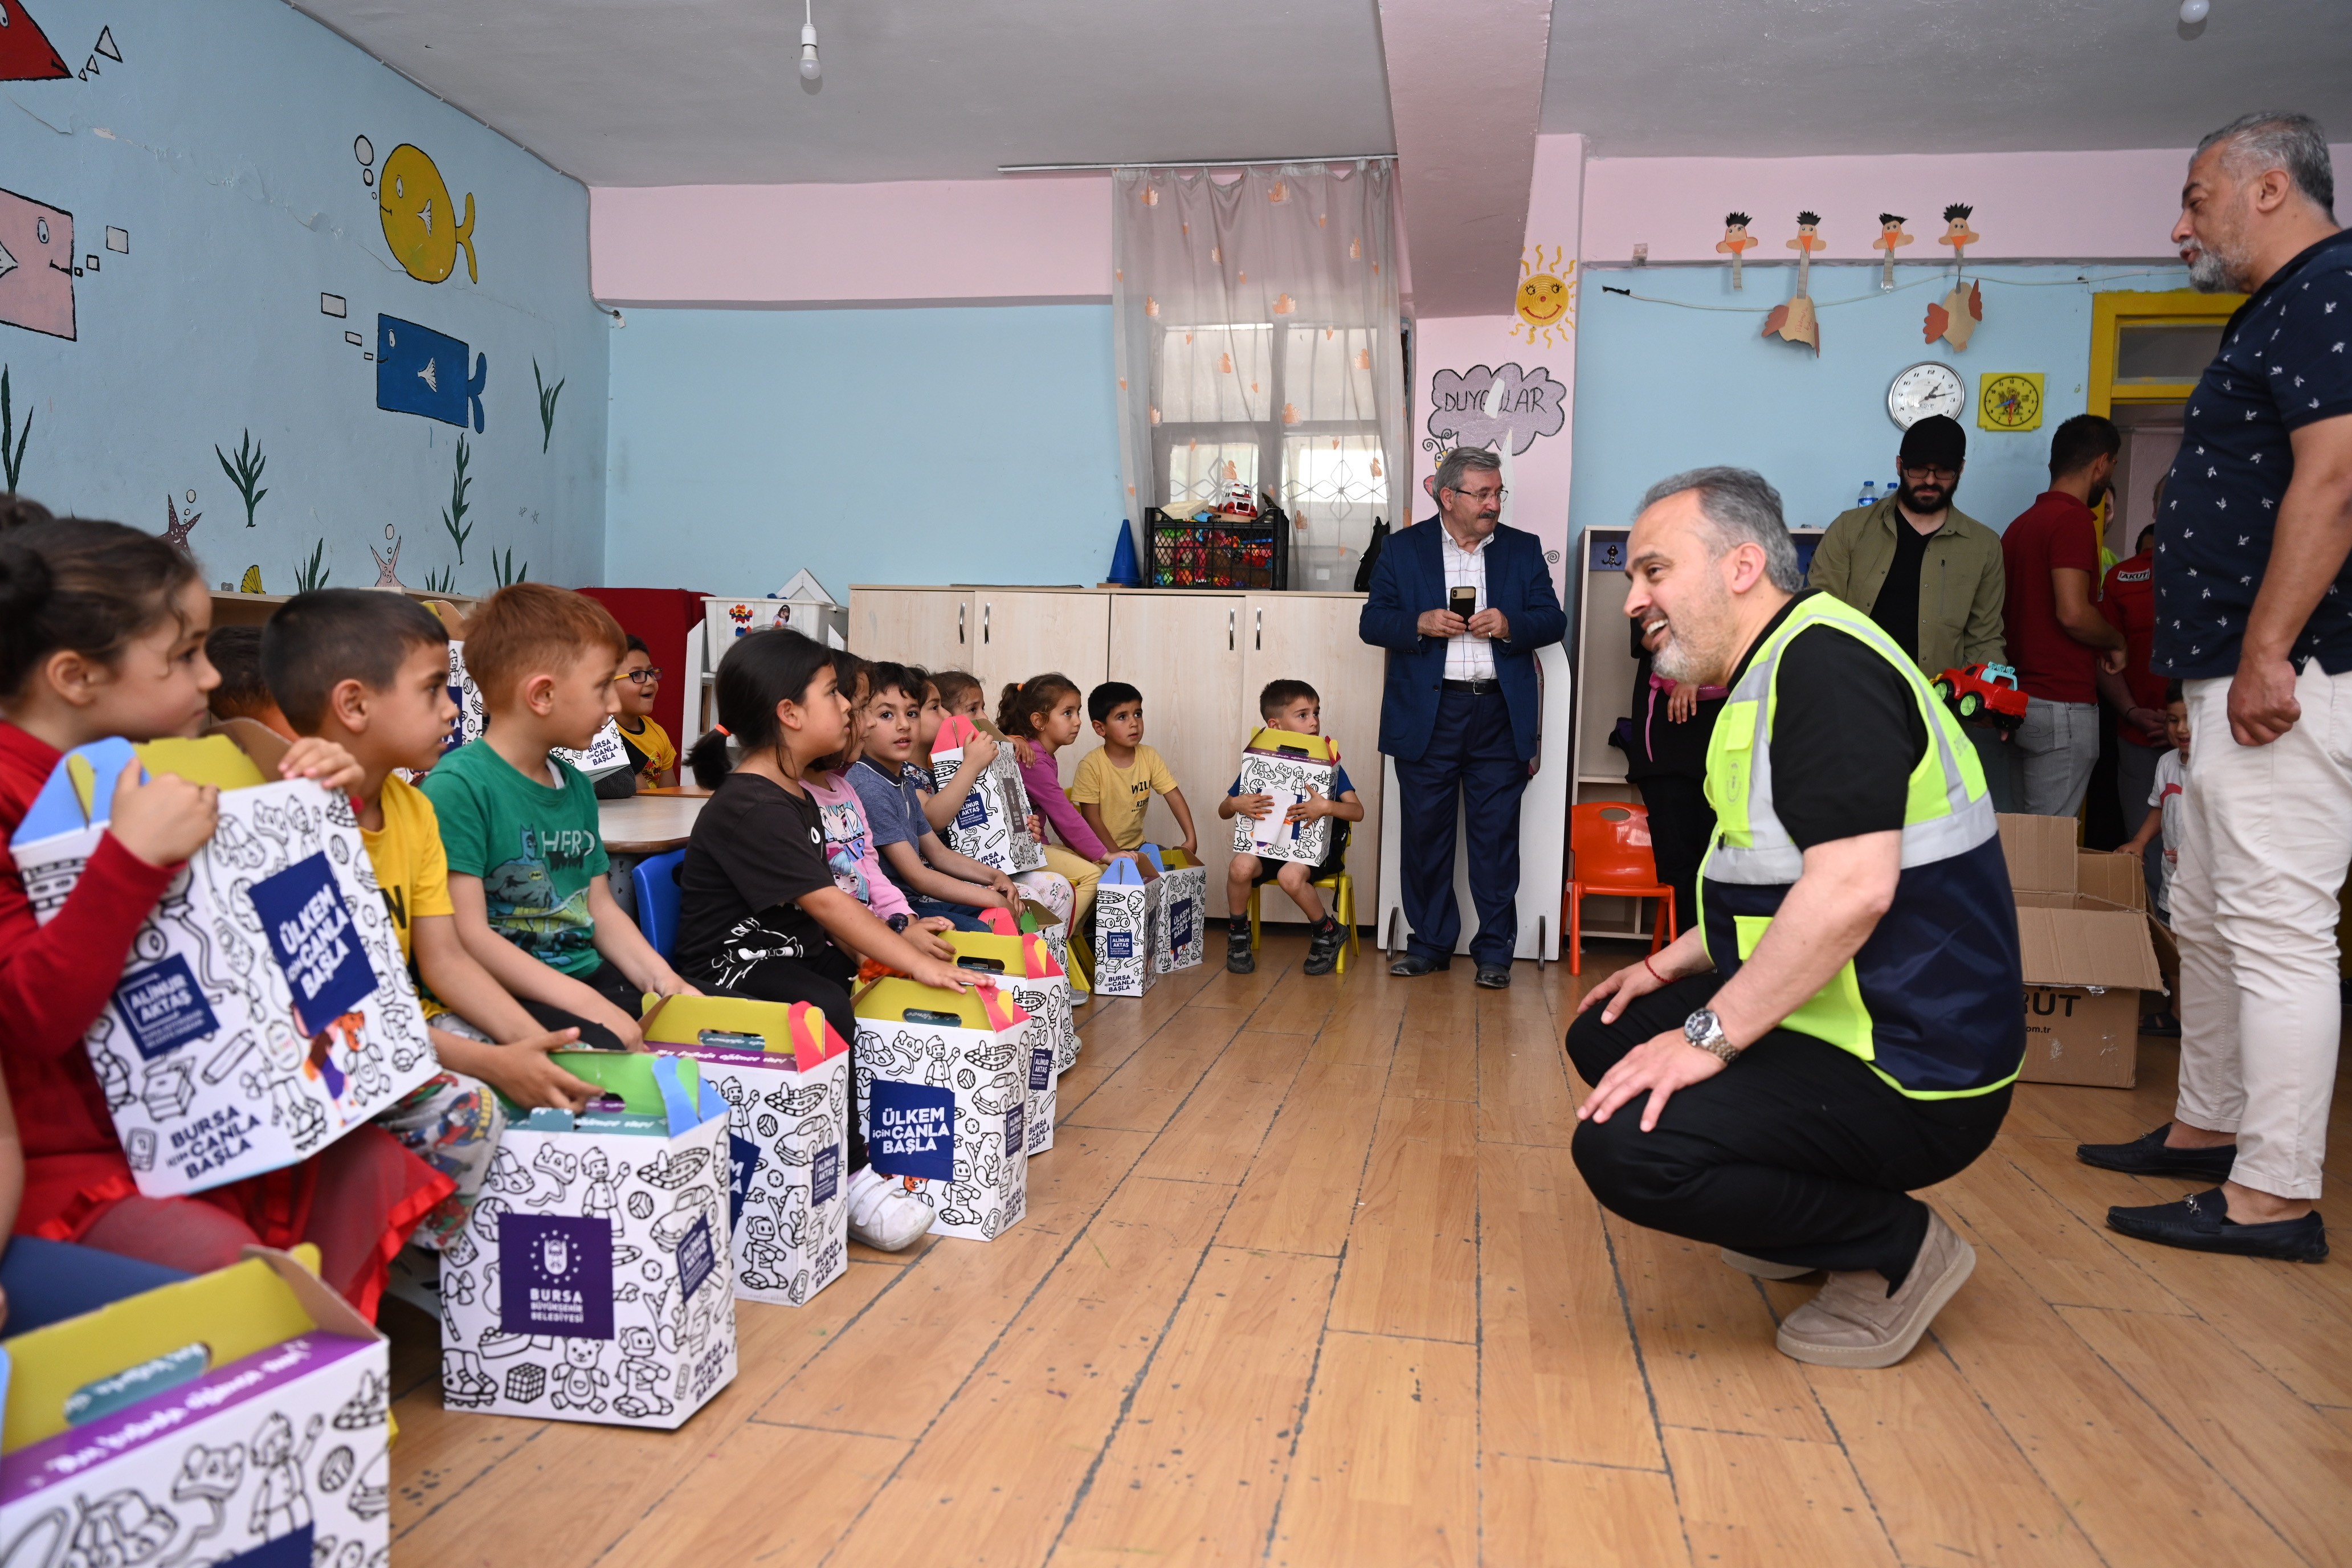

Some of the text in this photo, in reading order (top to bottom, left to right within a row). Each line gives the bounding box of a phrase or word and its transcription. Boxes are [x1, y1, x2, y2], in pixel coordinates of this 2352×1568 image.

[588, 738, 611, 753] BURSA
[594, 743, 618, 757] CANLA
[593, 752, 615, 766] BAŞLA
[962, 806, 980, 816] AKTAŞ
[978, 851, 999, 863] URSA
[279, 883, 337, 955] ÜLKEM
[1174, 907, 1190, 925] ÜLKEM
[1177, 914, 1191, 928] CANLA
[300, 906, 350, 968] CANLA
[1174, 923, 1188, 938] BAŞLA
[1035, 1065, 1047, 1074] AKTAŞ
[883, 1106, 945, 1126] ÜLKEM
[171, 1105, 240, 1149] BURSA
[191, 1114, 260, 1157] CANLA
[892, 1122, 950, 1140] CANLA
[1029, 1118, 1047, 1136] BURSA
[1032, 1124, 1050, 1141] CANLA
[883, 1137, 937, 1155] BAŞLA
[1028, 1134, 1046, 1152] BAŞLA
[186, 1138, 252, 1179] BAŞLA
[1006, 1185, 1022, 1210] BURSA
[1008, 1190, 1024, 1215] CANLA
[1004, 1203, 1021, 1228] BAŞLA
[815, 1238, 838, 1268] BURSA
[820, 1243, 842, 1273] CANLA
[816, 1259, 838, 1288] BAŞLA
[530, 1288, 583, 1303] BURSA
[531, 1312, 584, 1324] BELEDİYESİ
